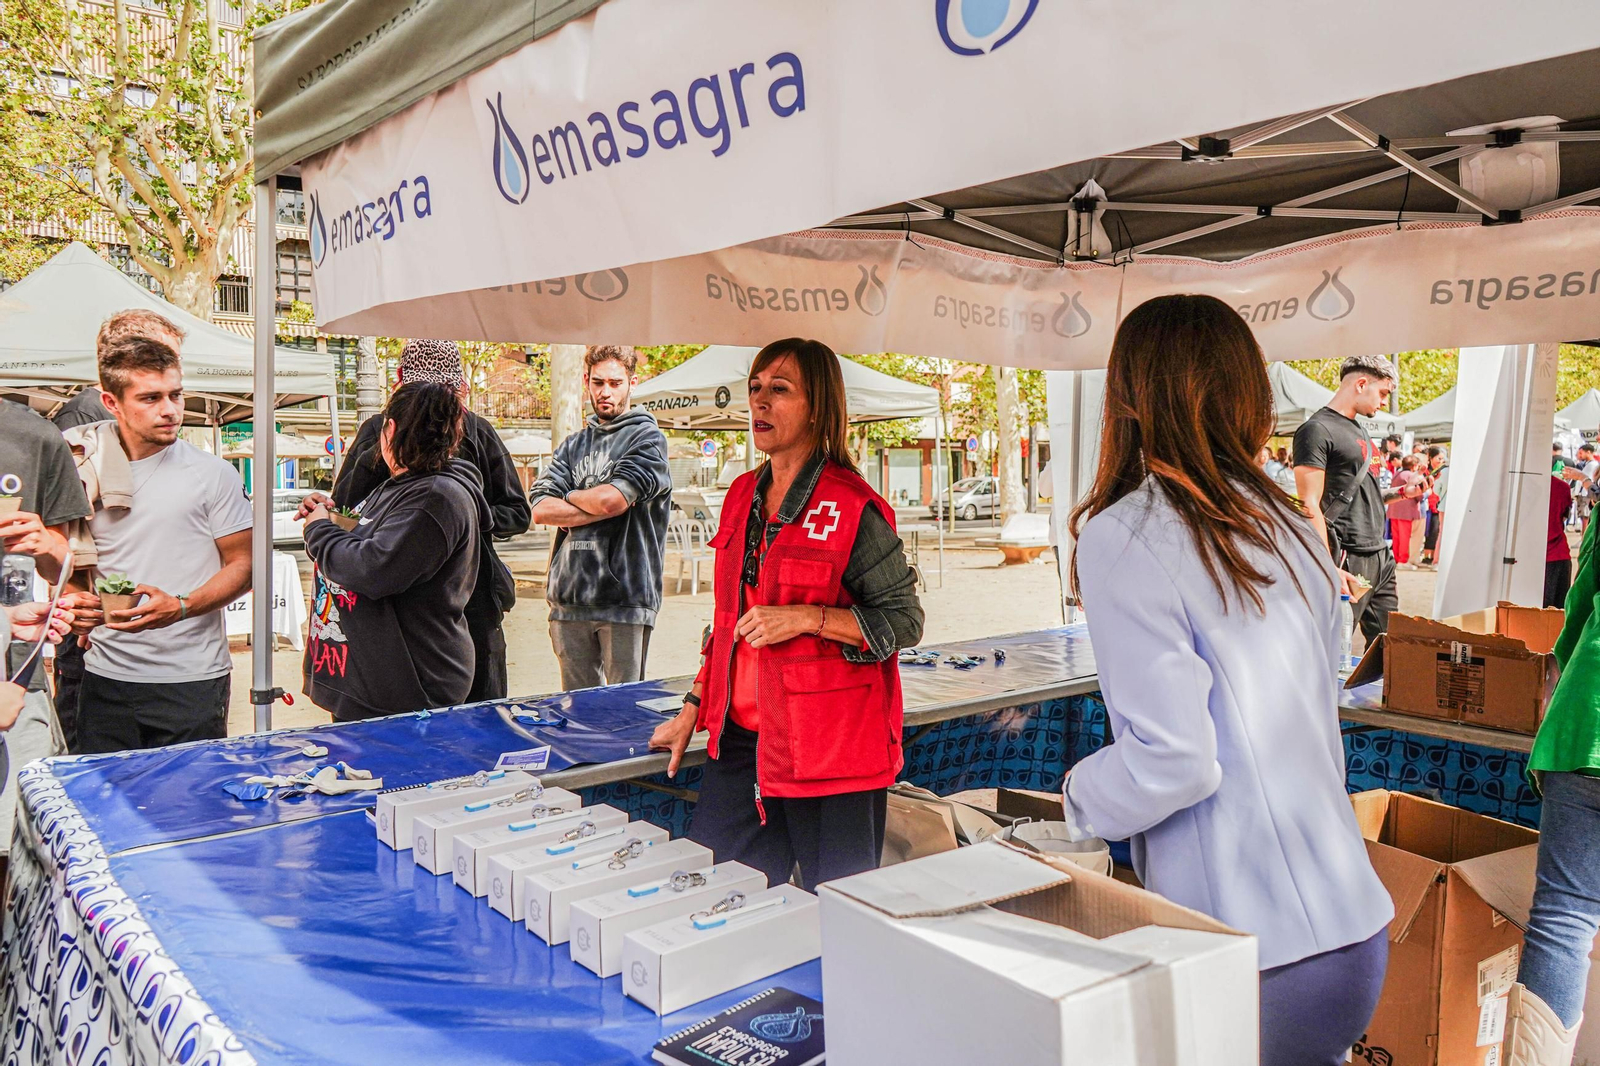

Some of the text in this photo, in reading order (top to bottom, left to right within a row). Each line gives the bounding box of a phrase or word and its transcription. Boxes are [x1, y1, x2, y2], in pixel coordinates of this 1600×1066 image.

[532, 51, 807, 185] emasagra
[331, 175, 432, 254] emasagra
[718, 1025, 789, 1059] EMASAGRA
